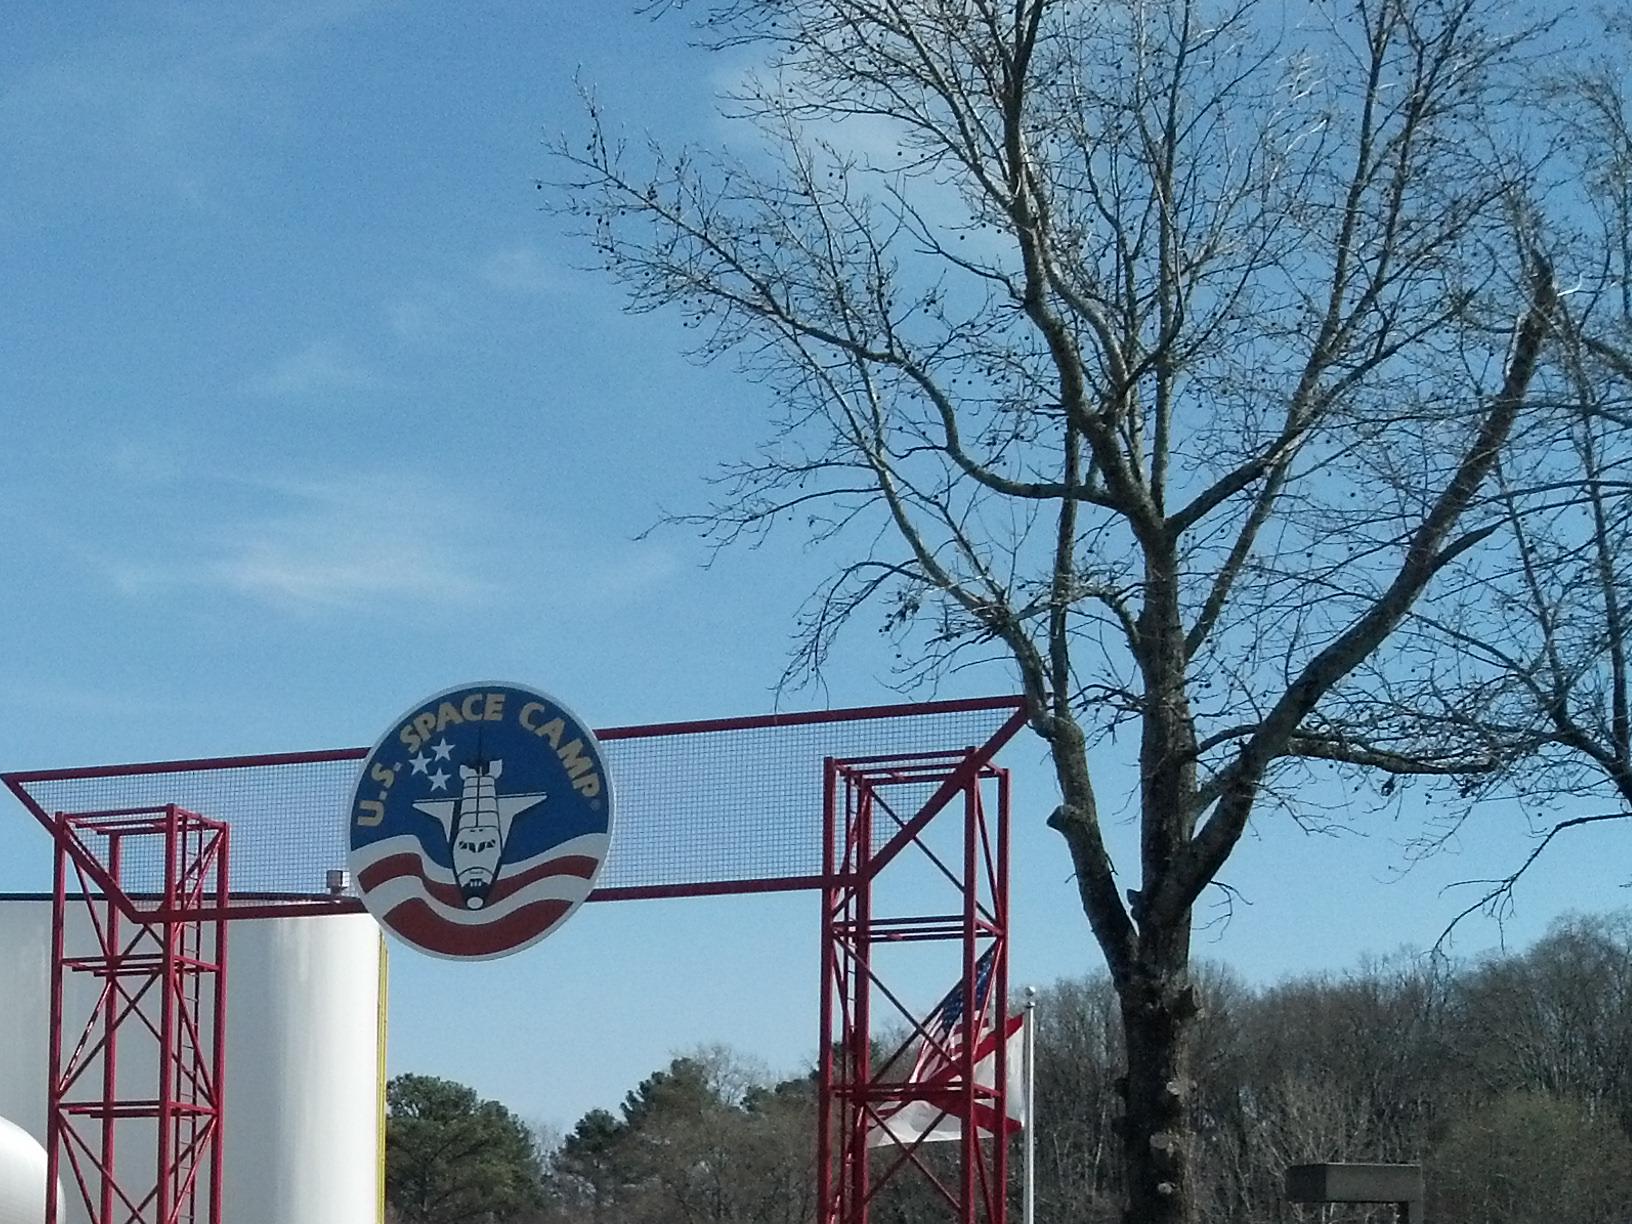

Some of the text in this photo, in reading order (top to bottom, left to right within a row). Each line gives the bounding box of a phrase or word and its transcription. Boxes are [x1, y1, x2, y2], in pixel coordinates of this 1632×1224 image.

[357, 693, 601, 827] U.S. SPACE CAMP
